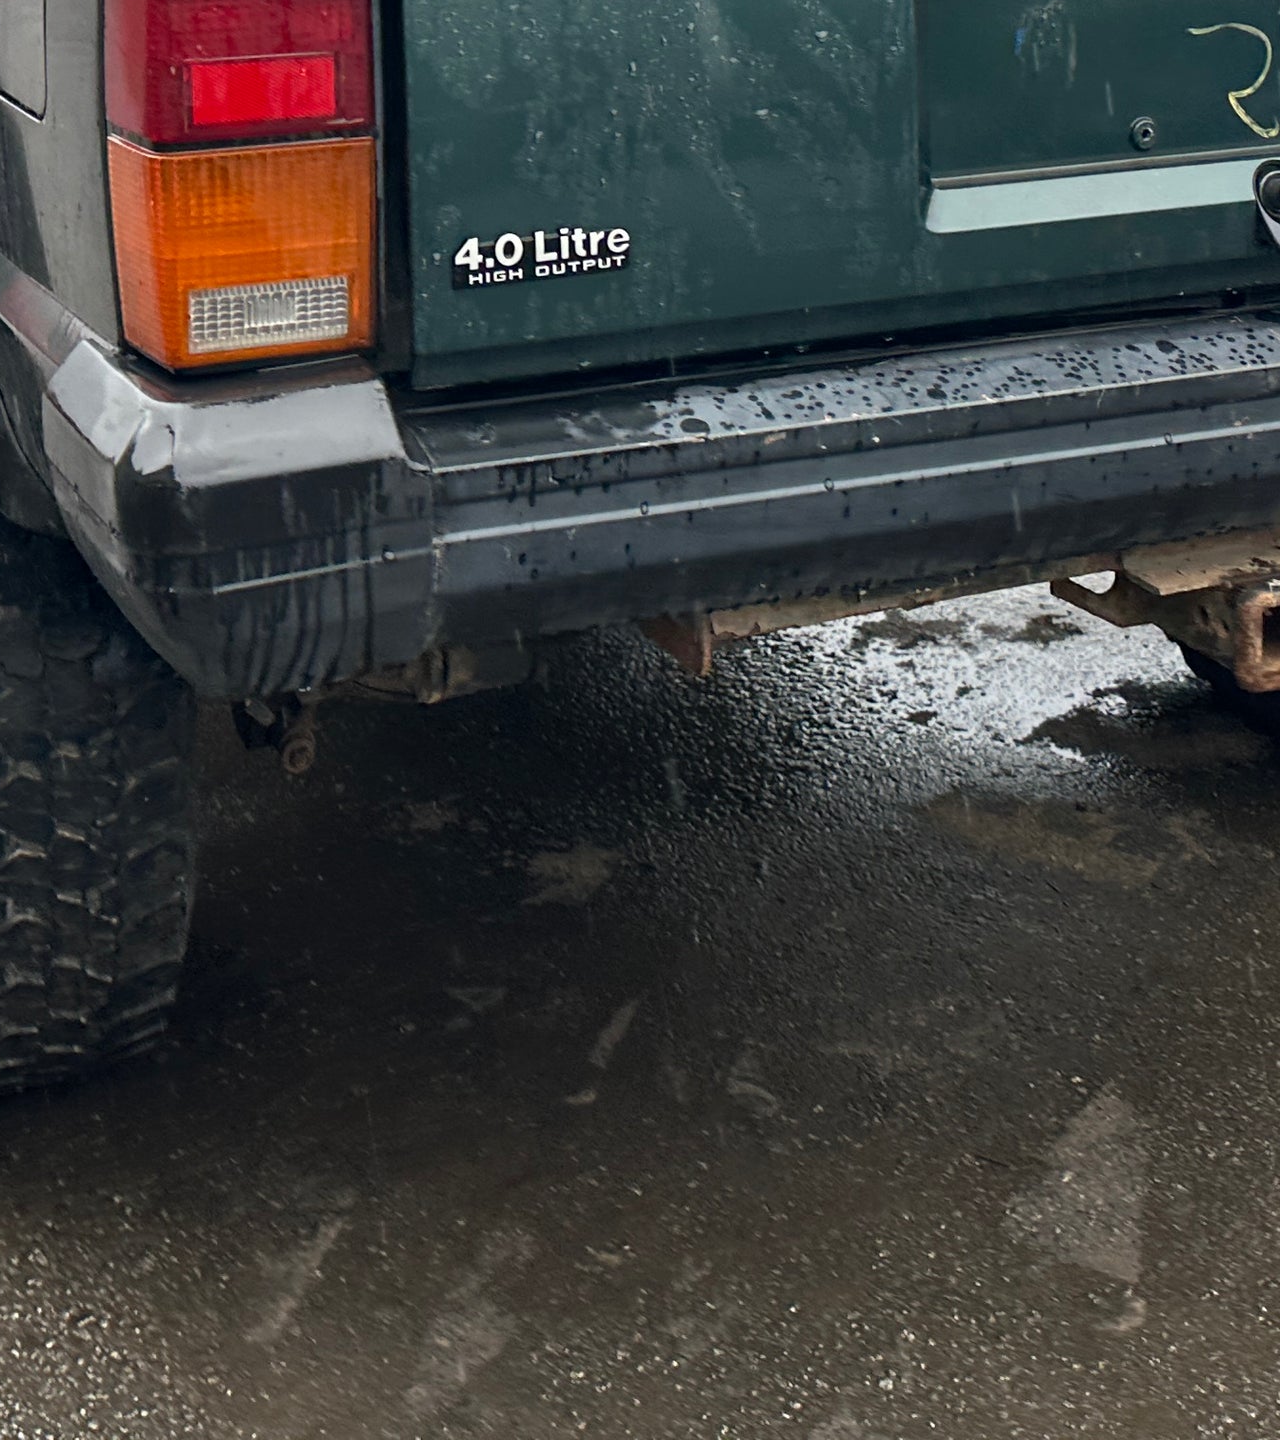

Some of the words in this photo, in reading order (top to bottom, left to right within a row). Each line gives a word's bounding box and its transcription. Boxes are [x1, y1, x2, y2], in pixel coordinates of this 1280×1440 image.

[455, 233, 524, 270] 4.0
[534, 227, 630, 262] Litre
[469, 269, 523, 285] HIGH
[535, 255, 625, 277] OUTPUT
